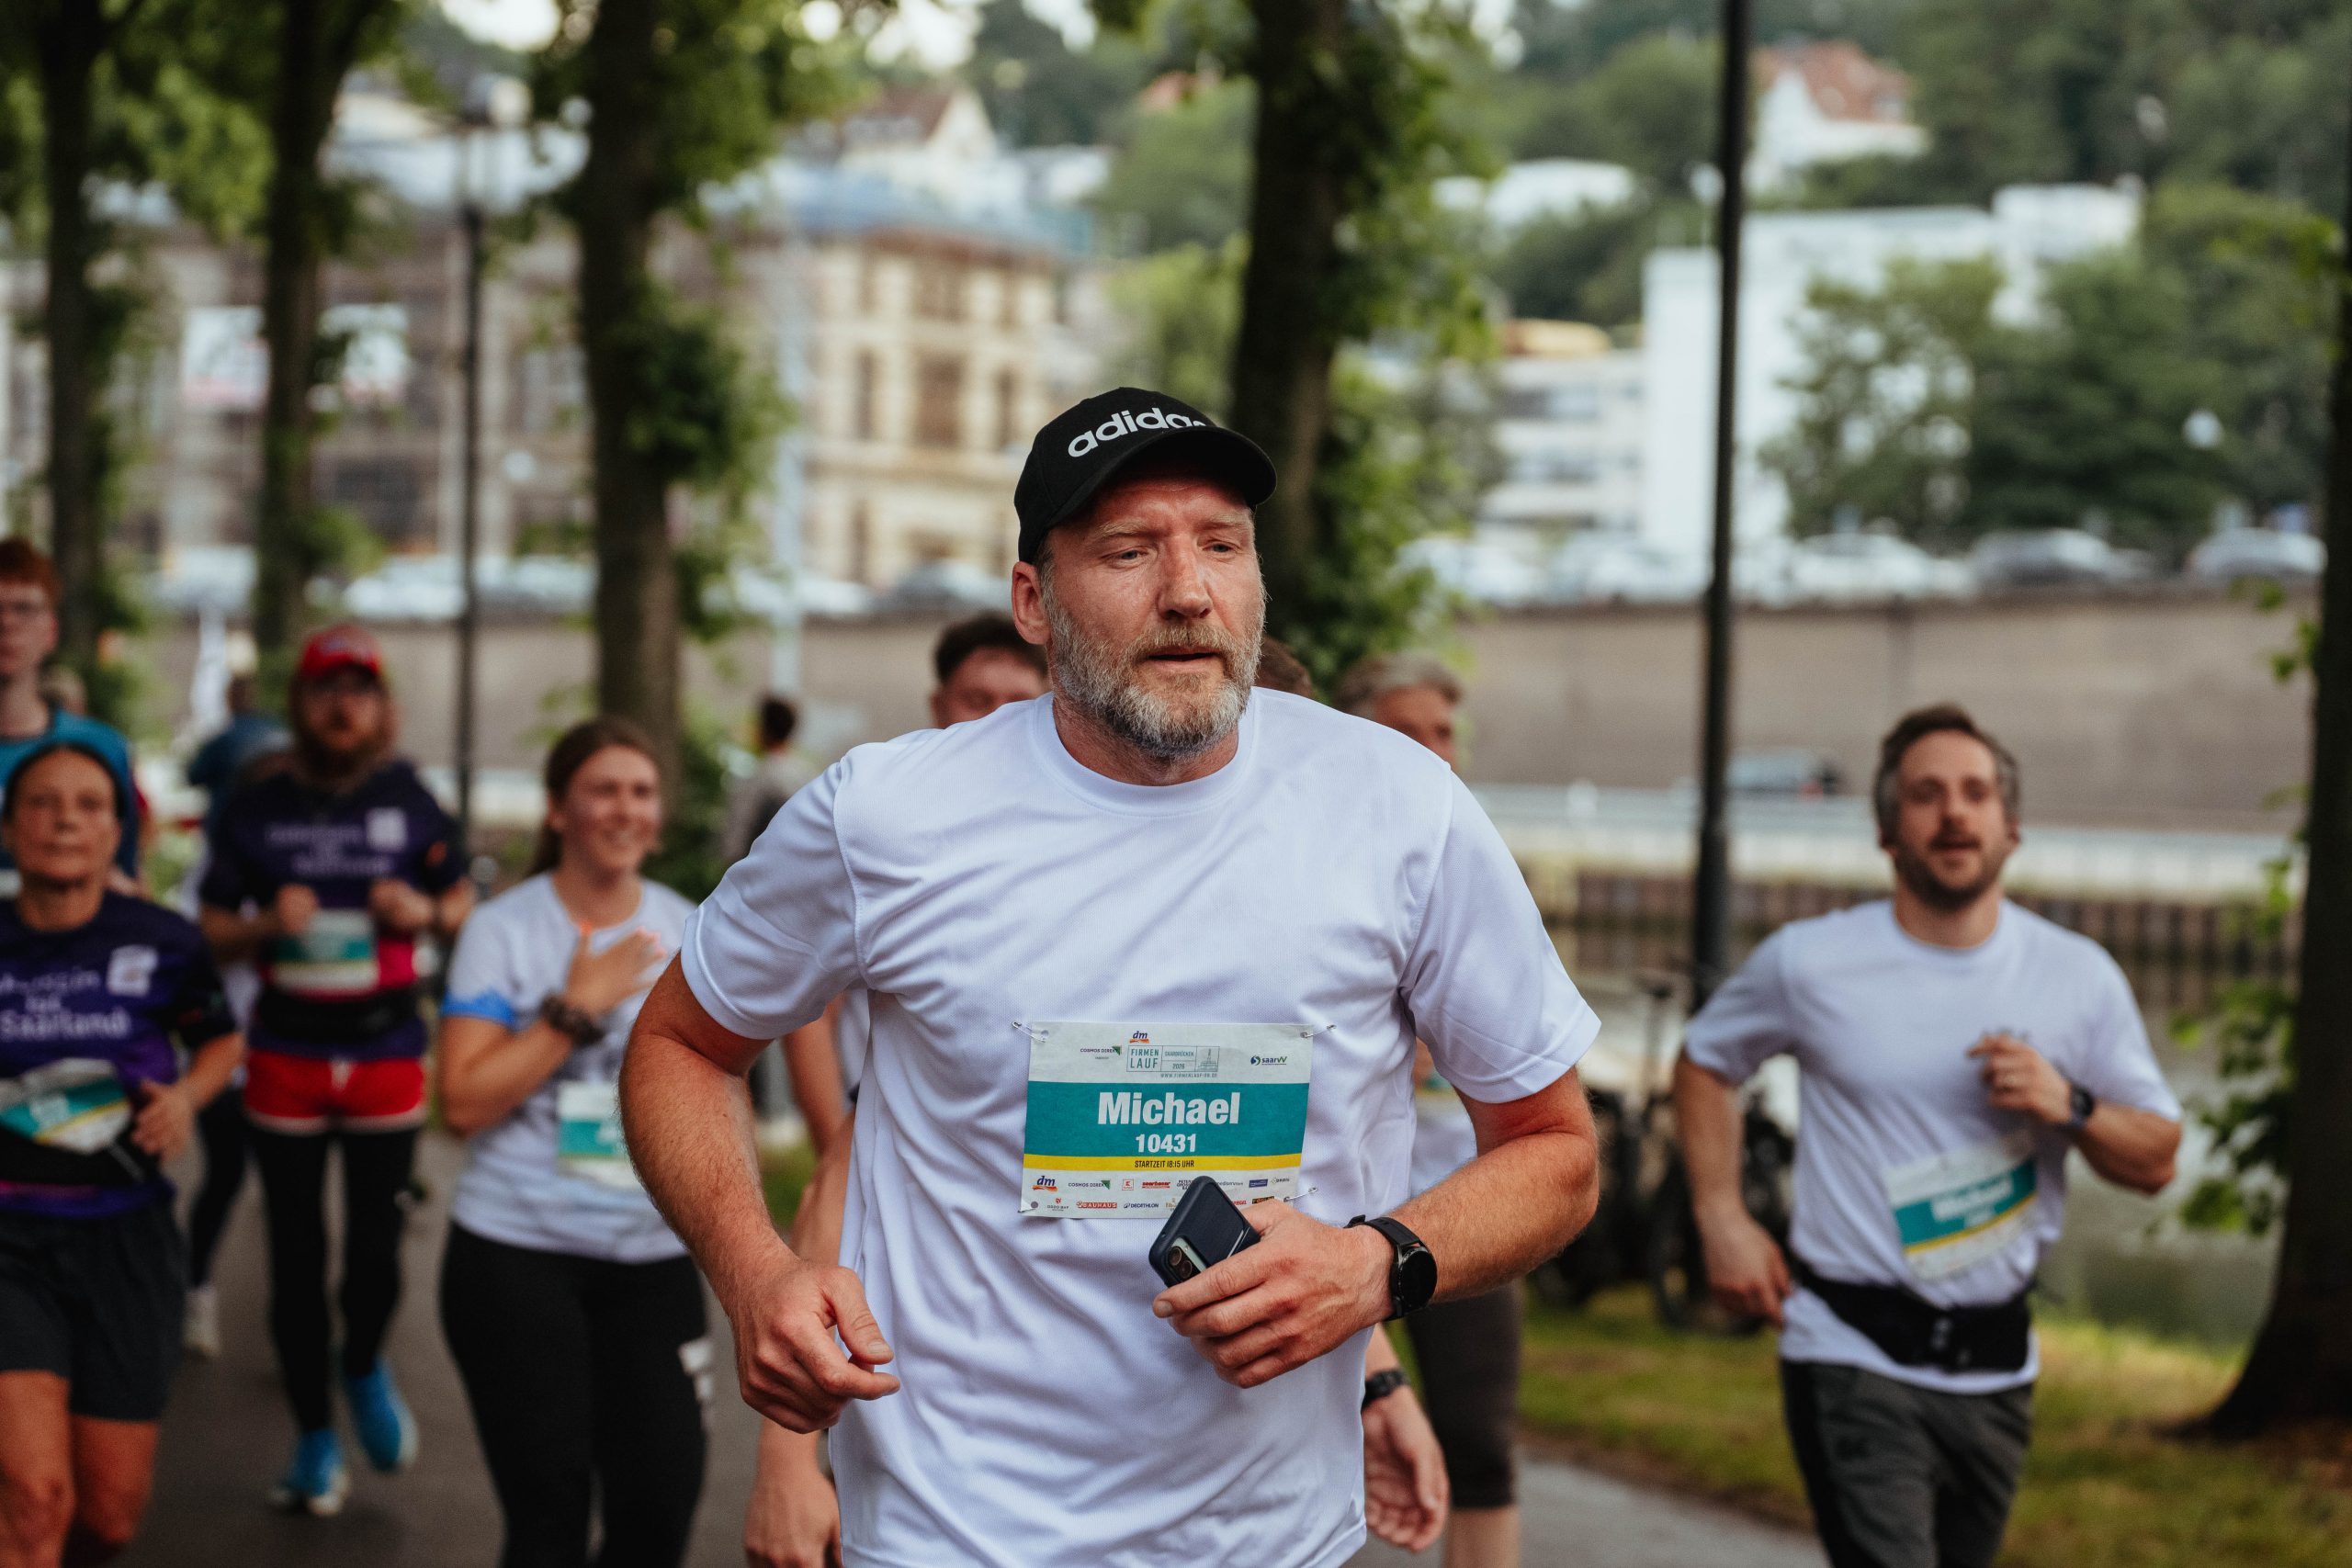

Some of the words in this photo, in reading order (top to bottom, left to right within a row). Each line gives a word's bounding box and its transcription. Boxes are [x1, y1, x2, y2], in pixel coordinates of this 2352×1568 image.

[1068, 407, 1206, 457] adida
[1130, 1048, 1159, 1056] FIRMEN
[1129, 1057, 1159, 1069] LAUF
[1098, 1091, 1241, 1125] Michael
[1135, 1133, 1197, 1154] 10431
[1134, 1159, 1166, 1168] STARTZEIT
[1166, 1159, 1182, 1168] 18:15
[1182, 1159, 1195, 1168] UHR
[1036, 1175, 1057, 1187] dm
